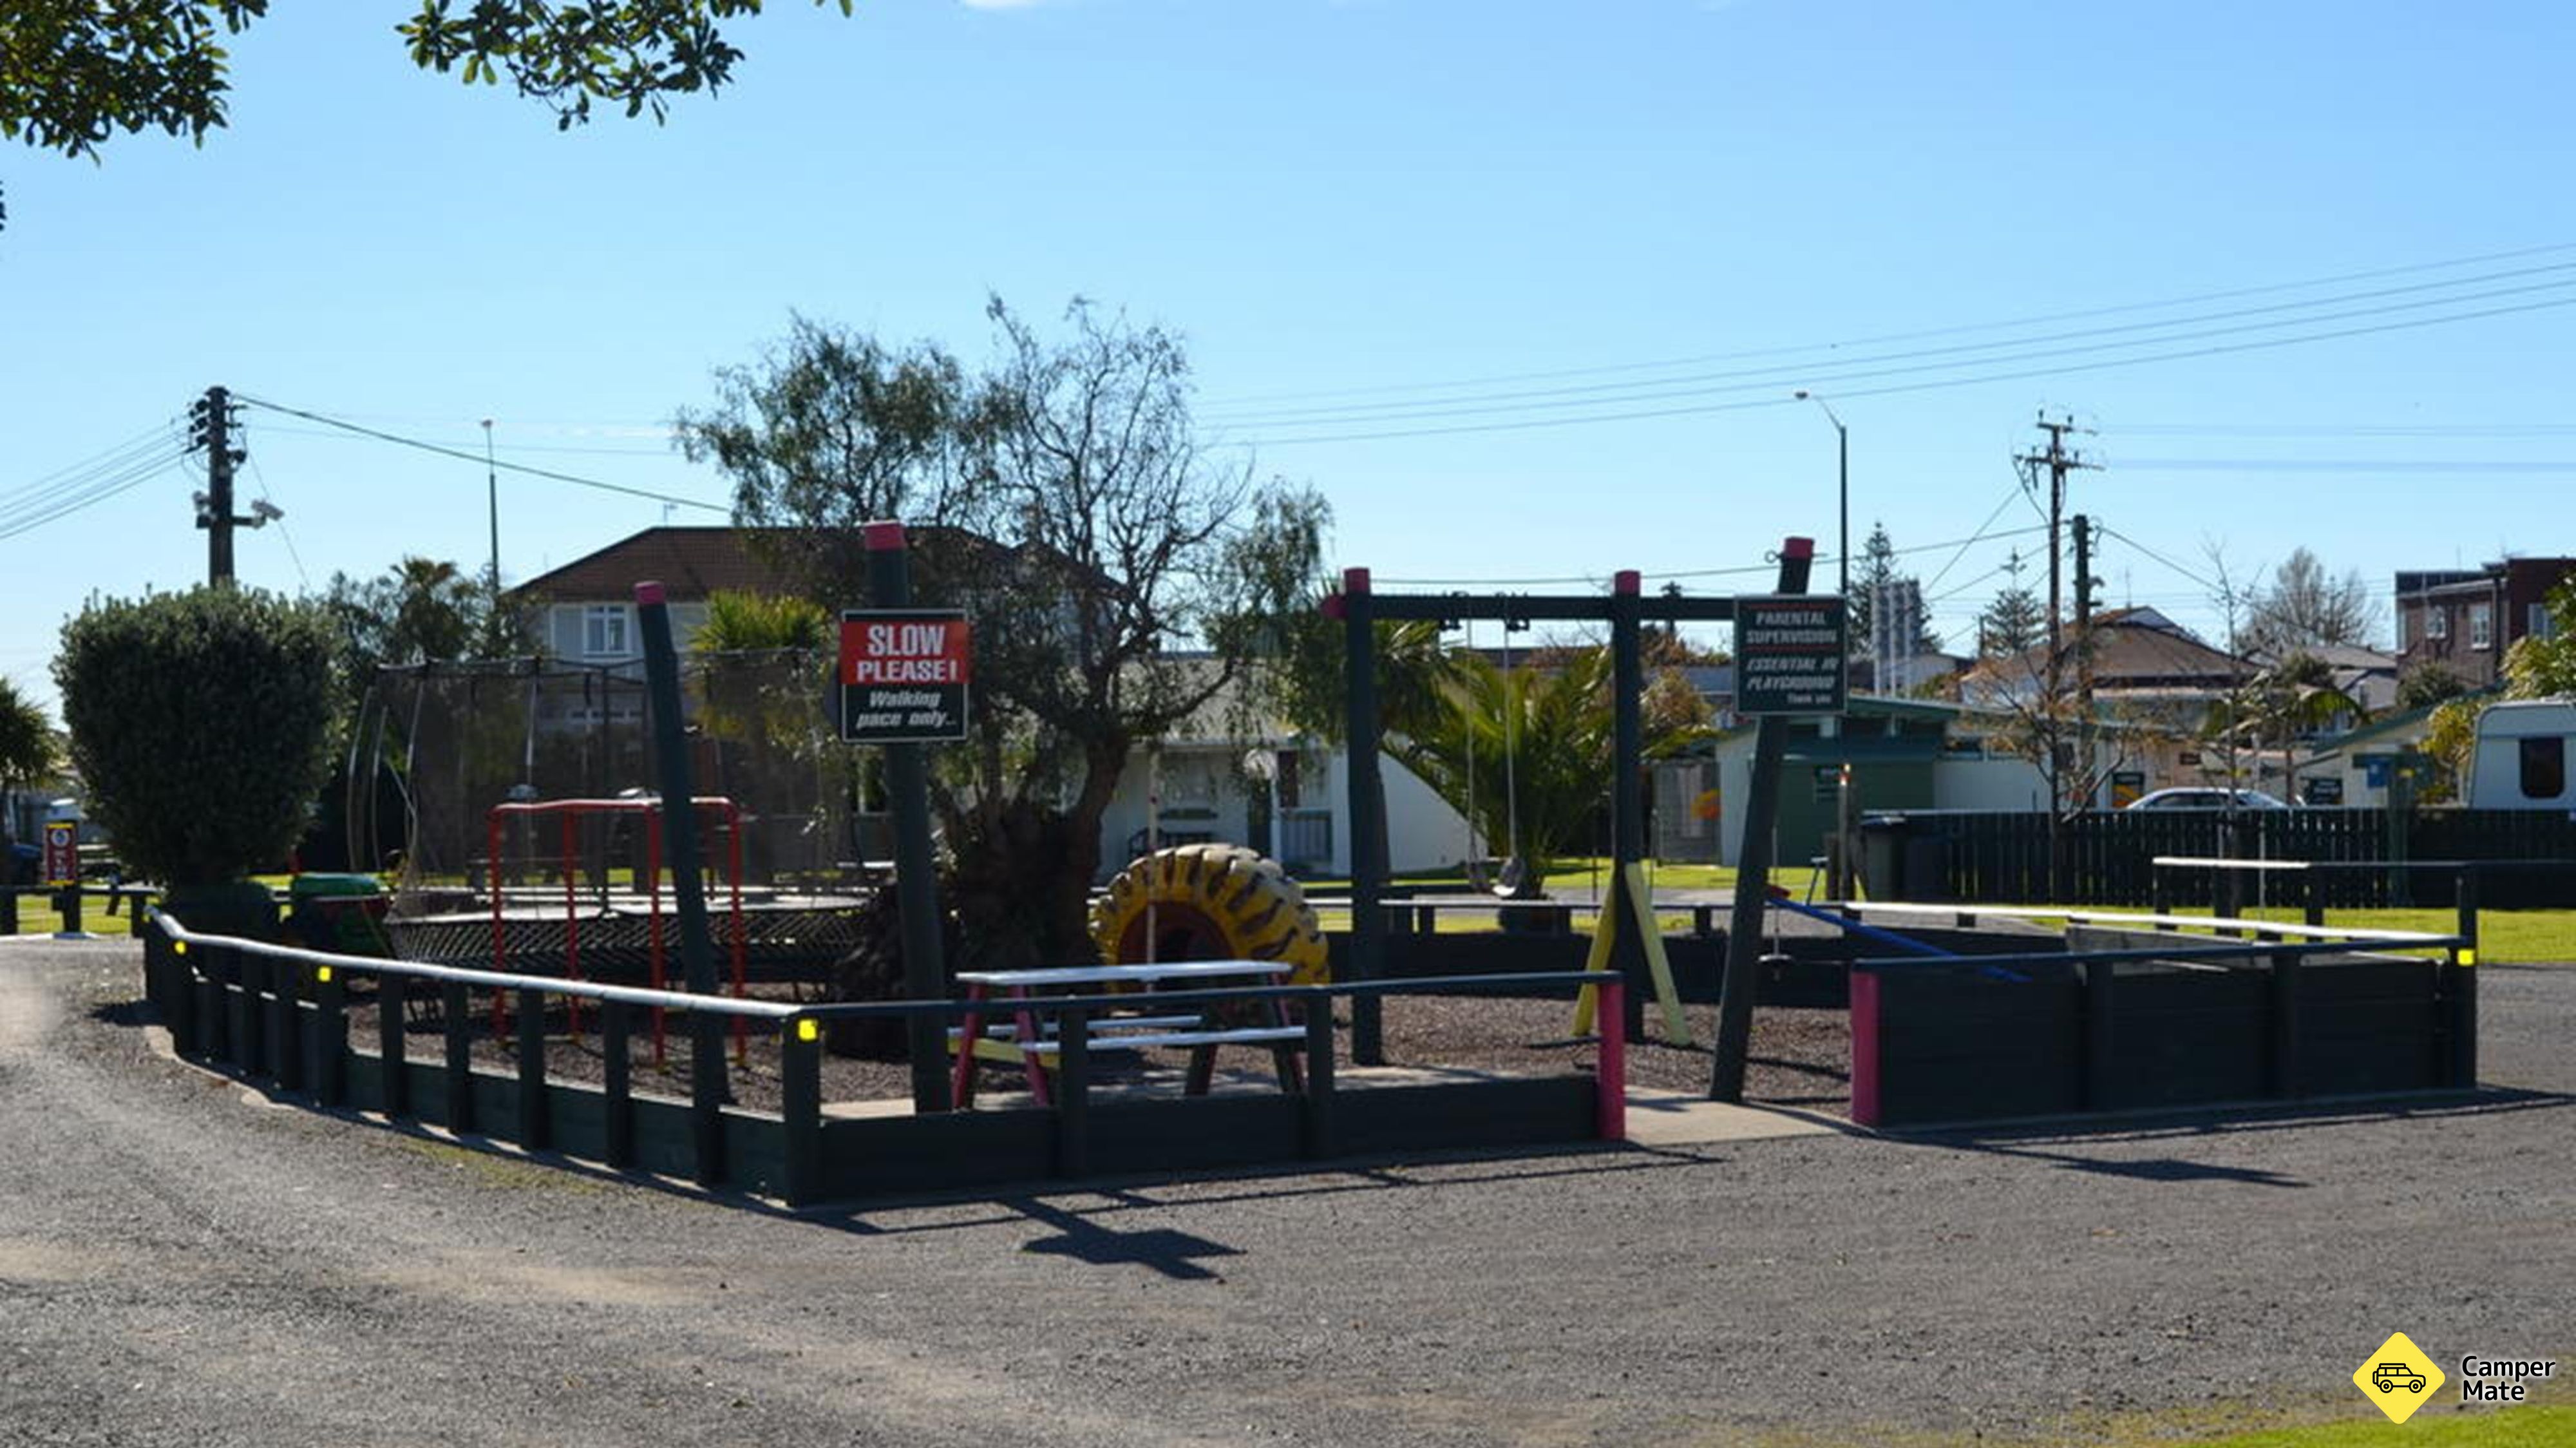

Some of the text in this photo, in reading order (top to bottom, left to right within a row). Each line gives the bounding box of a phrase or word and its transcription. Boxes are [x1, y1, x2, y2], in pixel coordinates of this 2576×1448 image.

[1756, 612, 1825, 625] PARENTAL
[867, 624, 945, 656] SLOW
[1746, 629, 1837, 643] SUPERVISION
[857, 659, 958, 682] PLEASE!
[1746, 657, 1839, 671] ESSENTIAL IN
[1746, 676, 1835, 691] PLAYGROUND
[869, 691, 941, 708] Walking
[855, 712, 902, 730] pace
